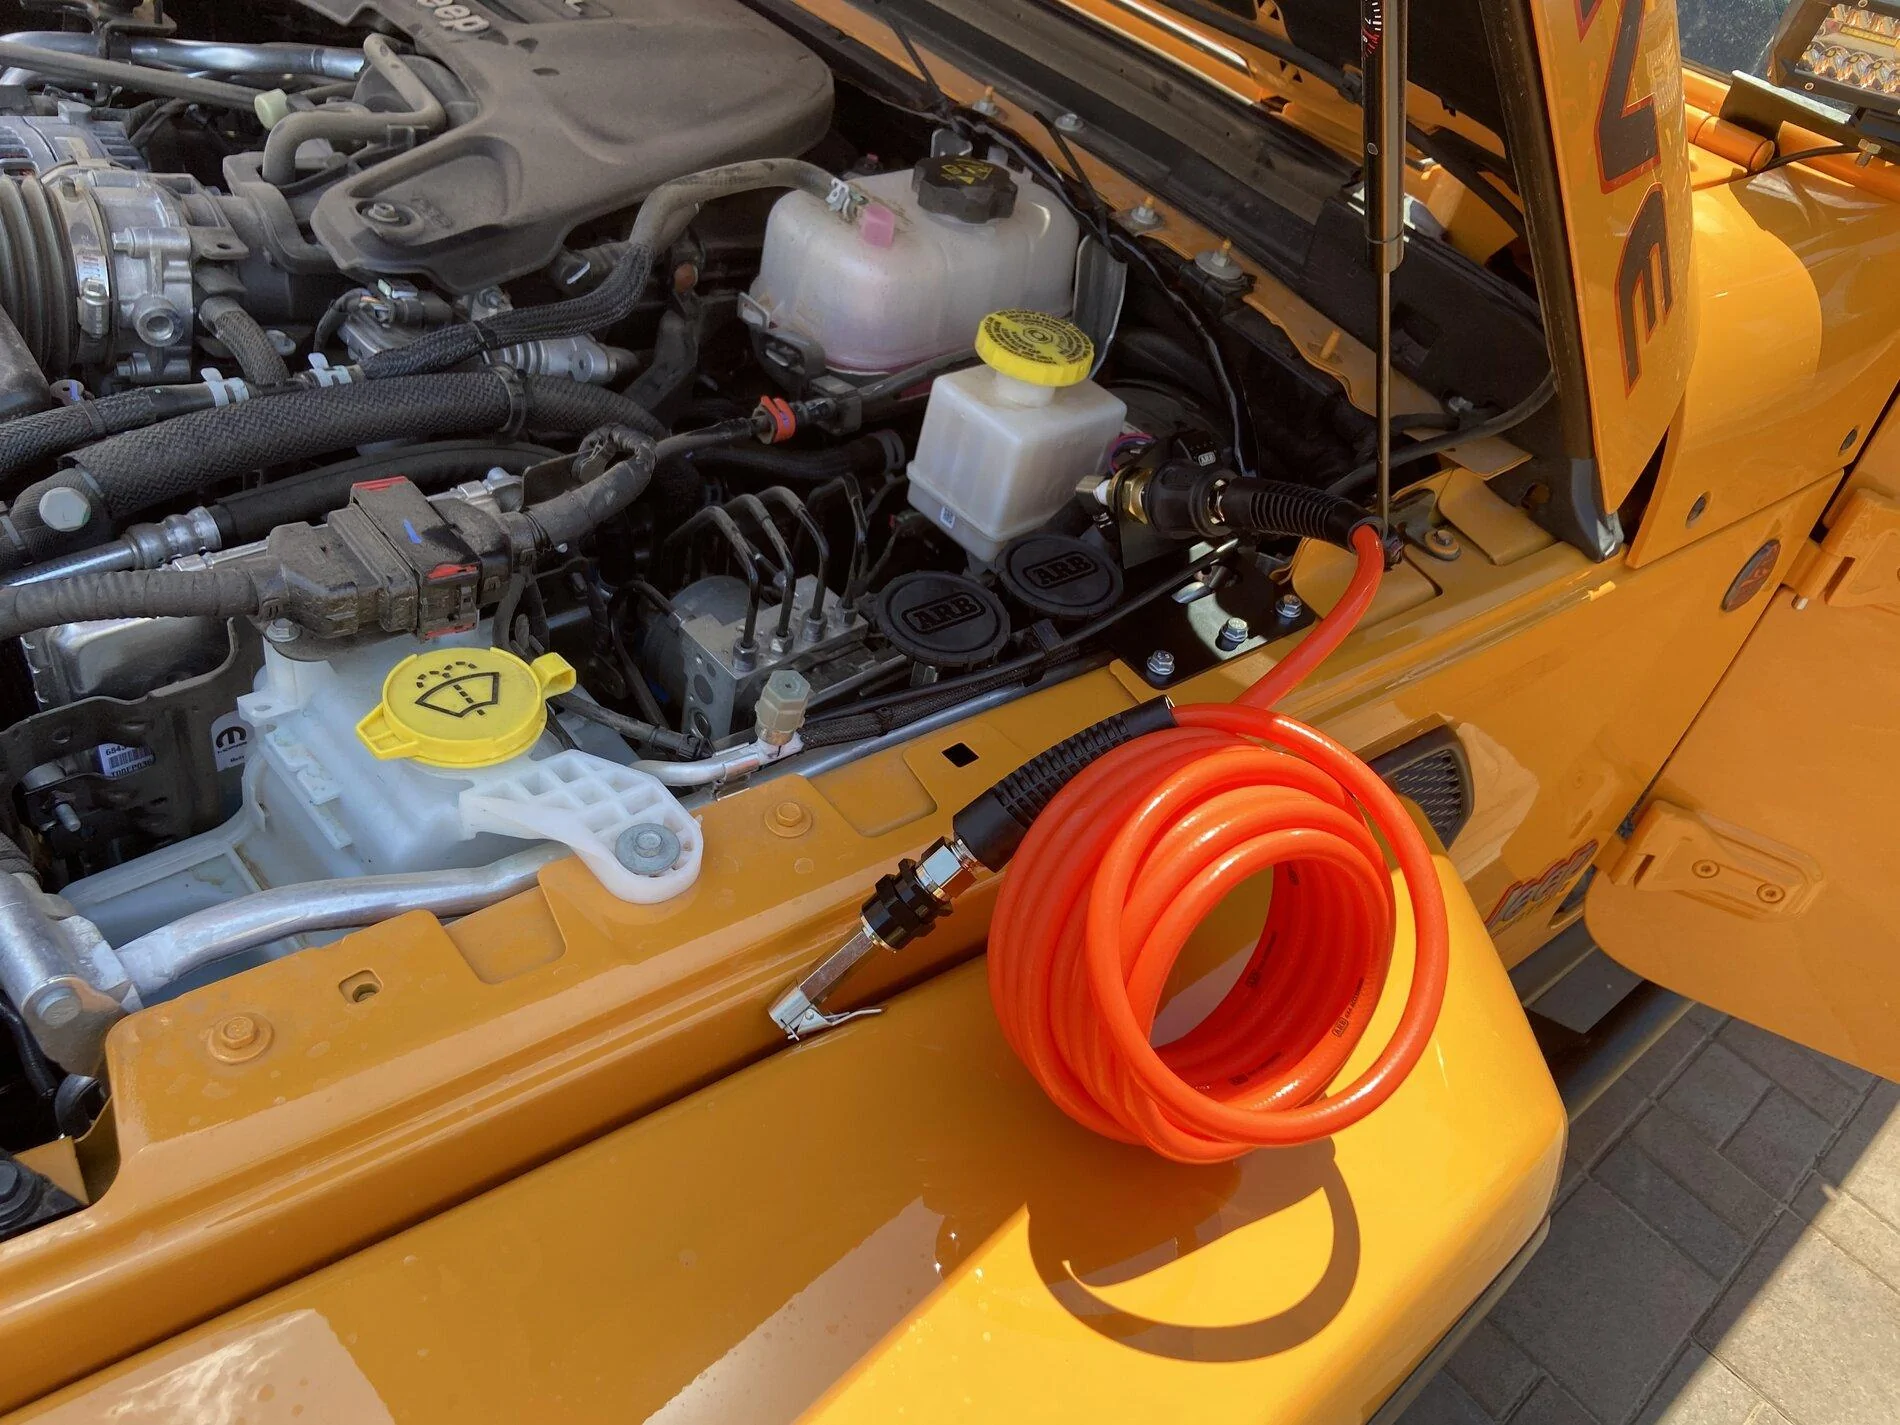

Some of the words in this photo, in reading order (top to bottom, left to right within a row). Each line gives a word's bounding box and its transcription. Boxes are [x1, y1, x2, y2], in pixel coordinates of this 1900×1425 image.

[1030, 553, 1094, 586] ARB
[910, 593, 979, 631] ARB
[1333, 1017, 1348, 1036] ARB
